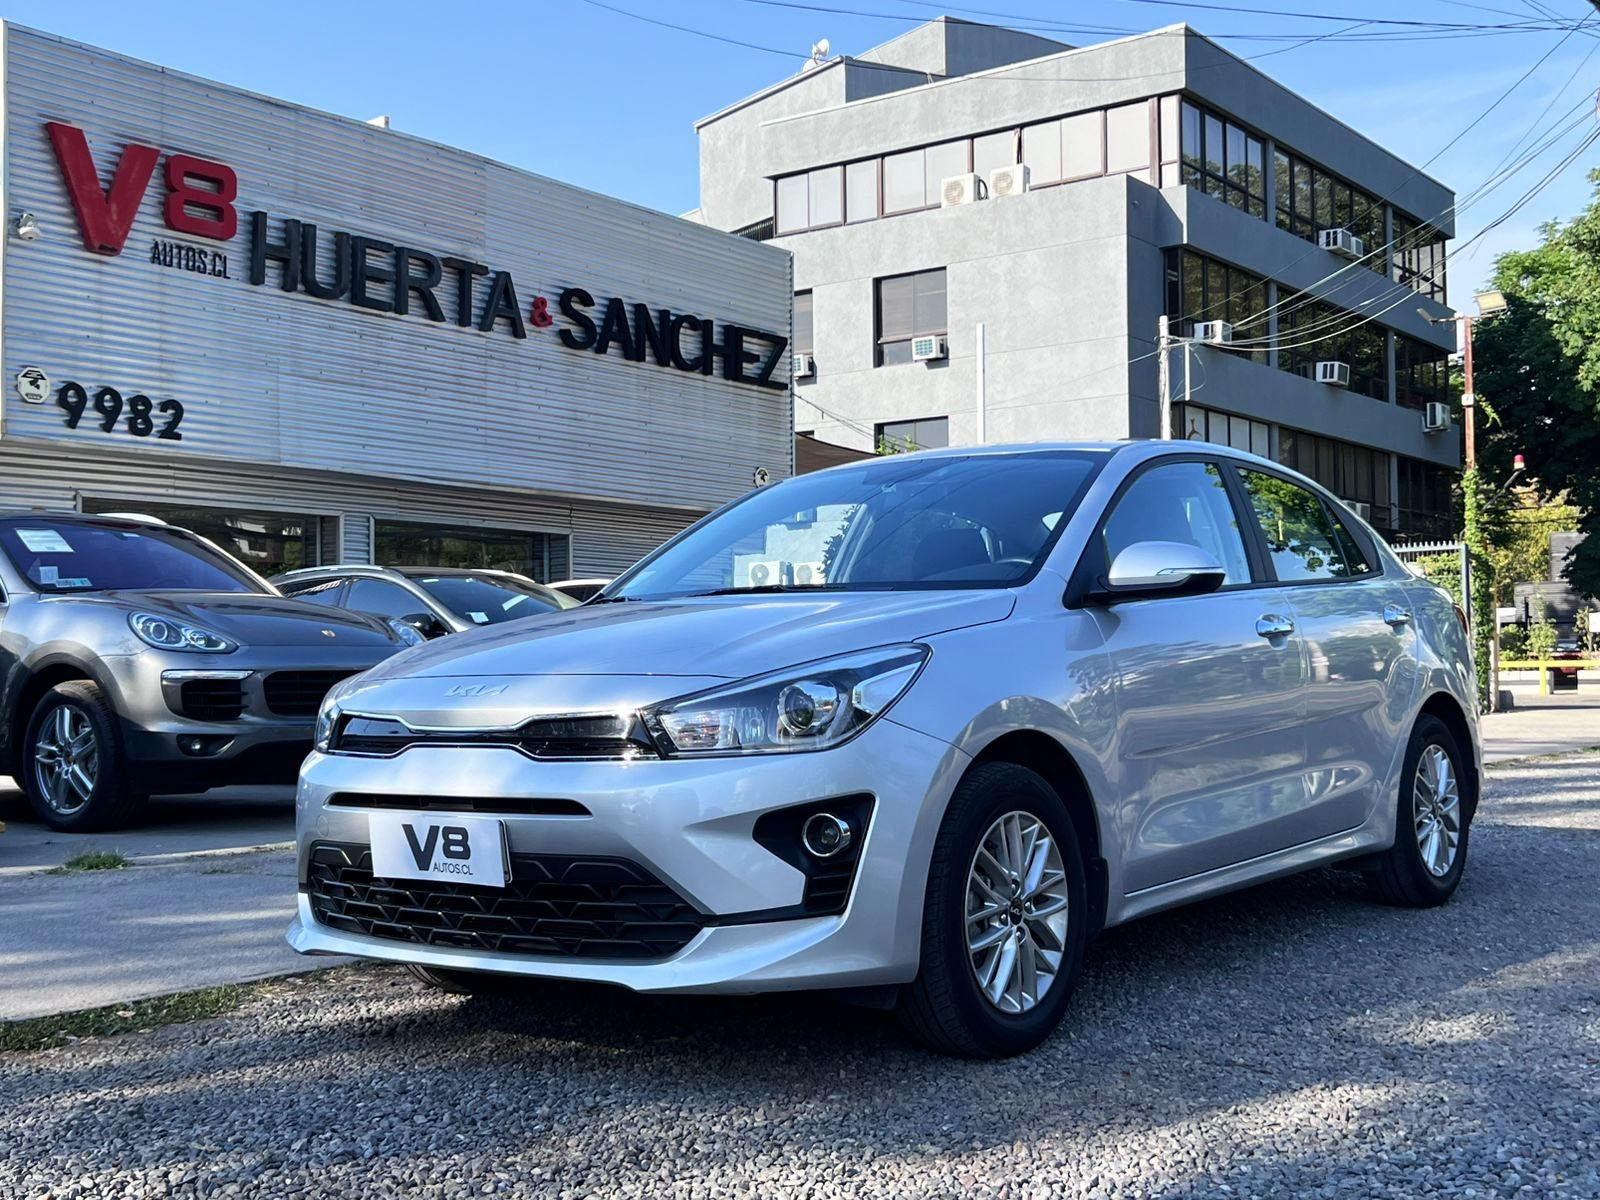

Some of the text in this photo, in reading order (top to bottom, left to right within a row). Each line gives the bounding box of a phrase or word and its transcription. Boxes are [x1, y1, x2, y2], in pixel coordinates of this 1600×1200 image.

[45, 121, 238, 257] V8
[150, 239, 231, 280] AUTOS.CL
[249, 211, 789, 391] HUERTA & SANCHEZ
[57, 381, 183, 441] 9982
[401, 823, 472, 872] V8
[432, 861, 474, 876] AUTOS.CL
